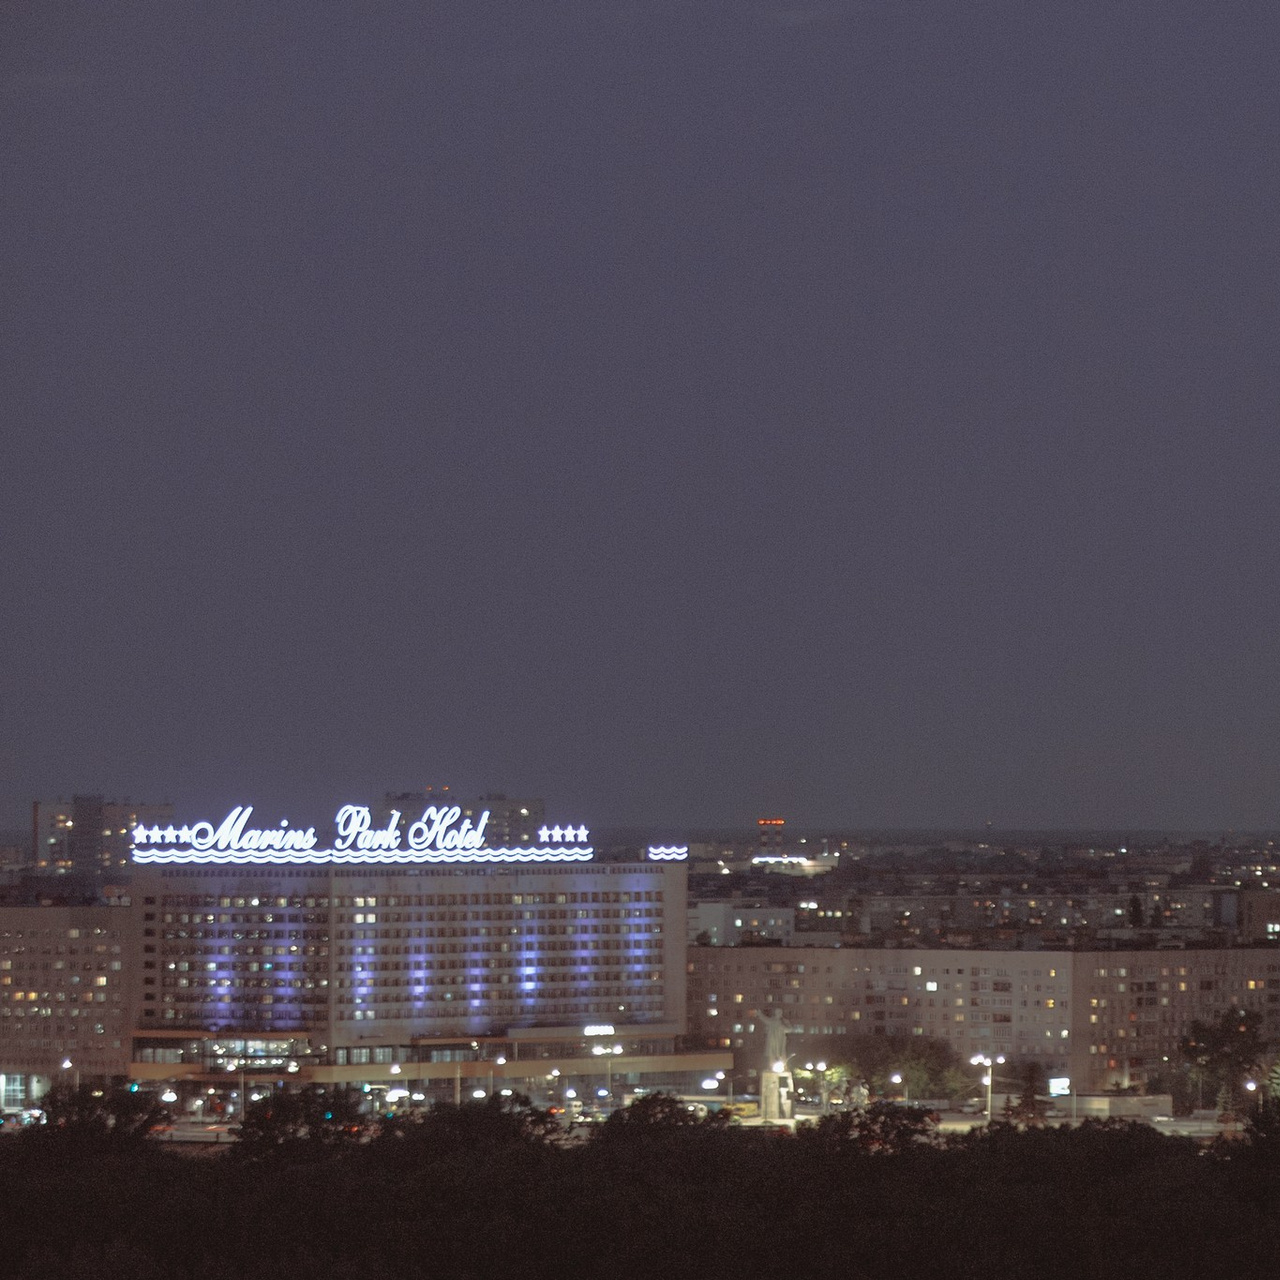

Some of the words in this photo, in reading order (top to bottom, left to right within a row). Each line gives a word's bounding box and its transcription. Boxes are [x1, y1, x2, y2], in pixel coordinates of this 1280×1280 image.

[191, 806, 318, 850] Marins
[335, 804, 401, 849] Park
[408, 805, 490, 849] Hotel
